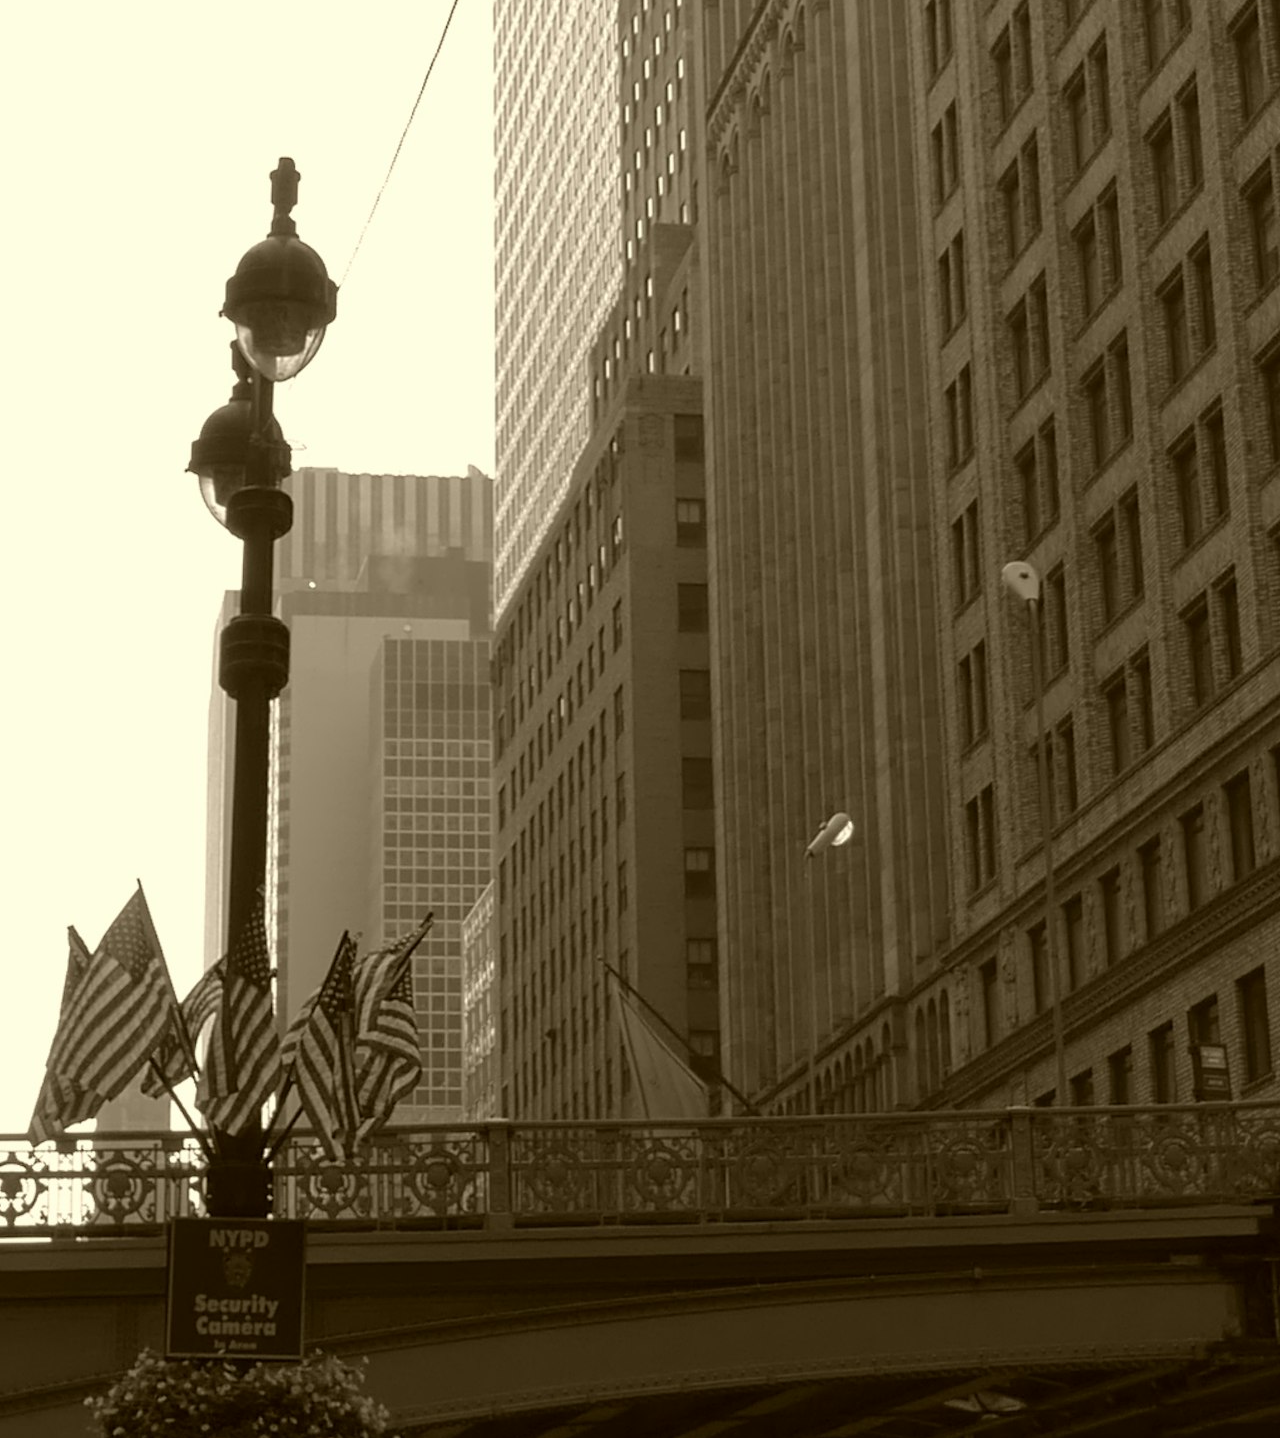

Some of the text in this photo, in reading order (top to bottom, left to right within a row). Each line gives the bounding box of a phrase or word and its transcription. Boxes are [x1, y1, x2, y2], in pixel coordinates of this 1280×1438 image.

[208, 1228, 270, 1248] NYPD
[193, 1293, 280, 1319] Security
[195, 1314, 277, 1336] Camera
